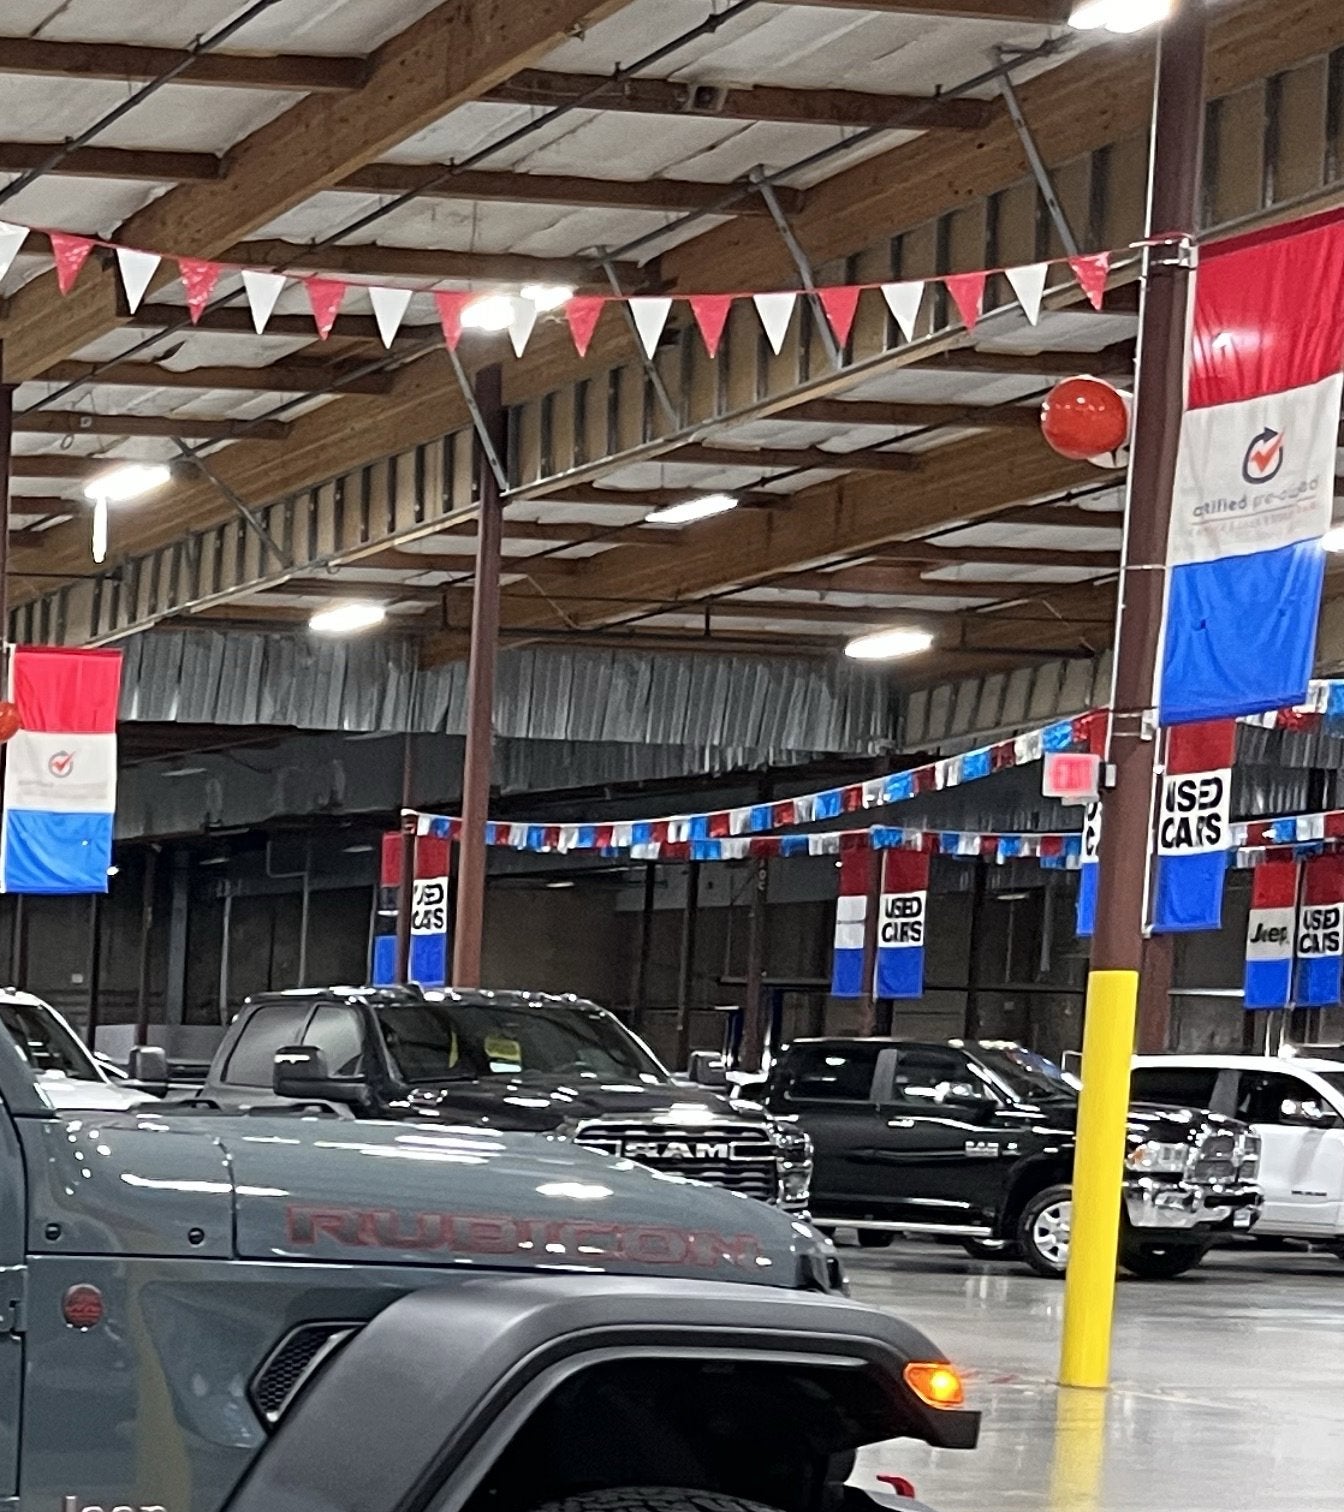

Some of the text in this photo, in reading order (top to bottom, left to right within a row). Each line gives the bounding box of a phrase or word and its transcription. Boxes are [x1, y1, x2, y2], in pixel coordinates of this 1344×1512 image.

[412, 909, 444, 929] CAS
[1304, 908, 1340, 930] USED
[625, 1142, 728, 1158] RAM
[285, 1205, 771, 1269] RUBICON
